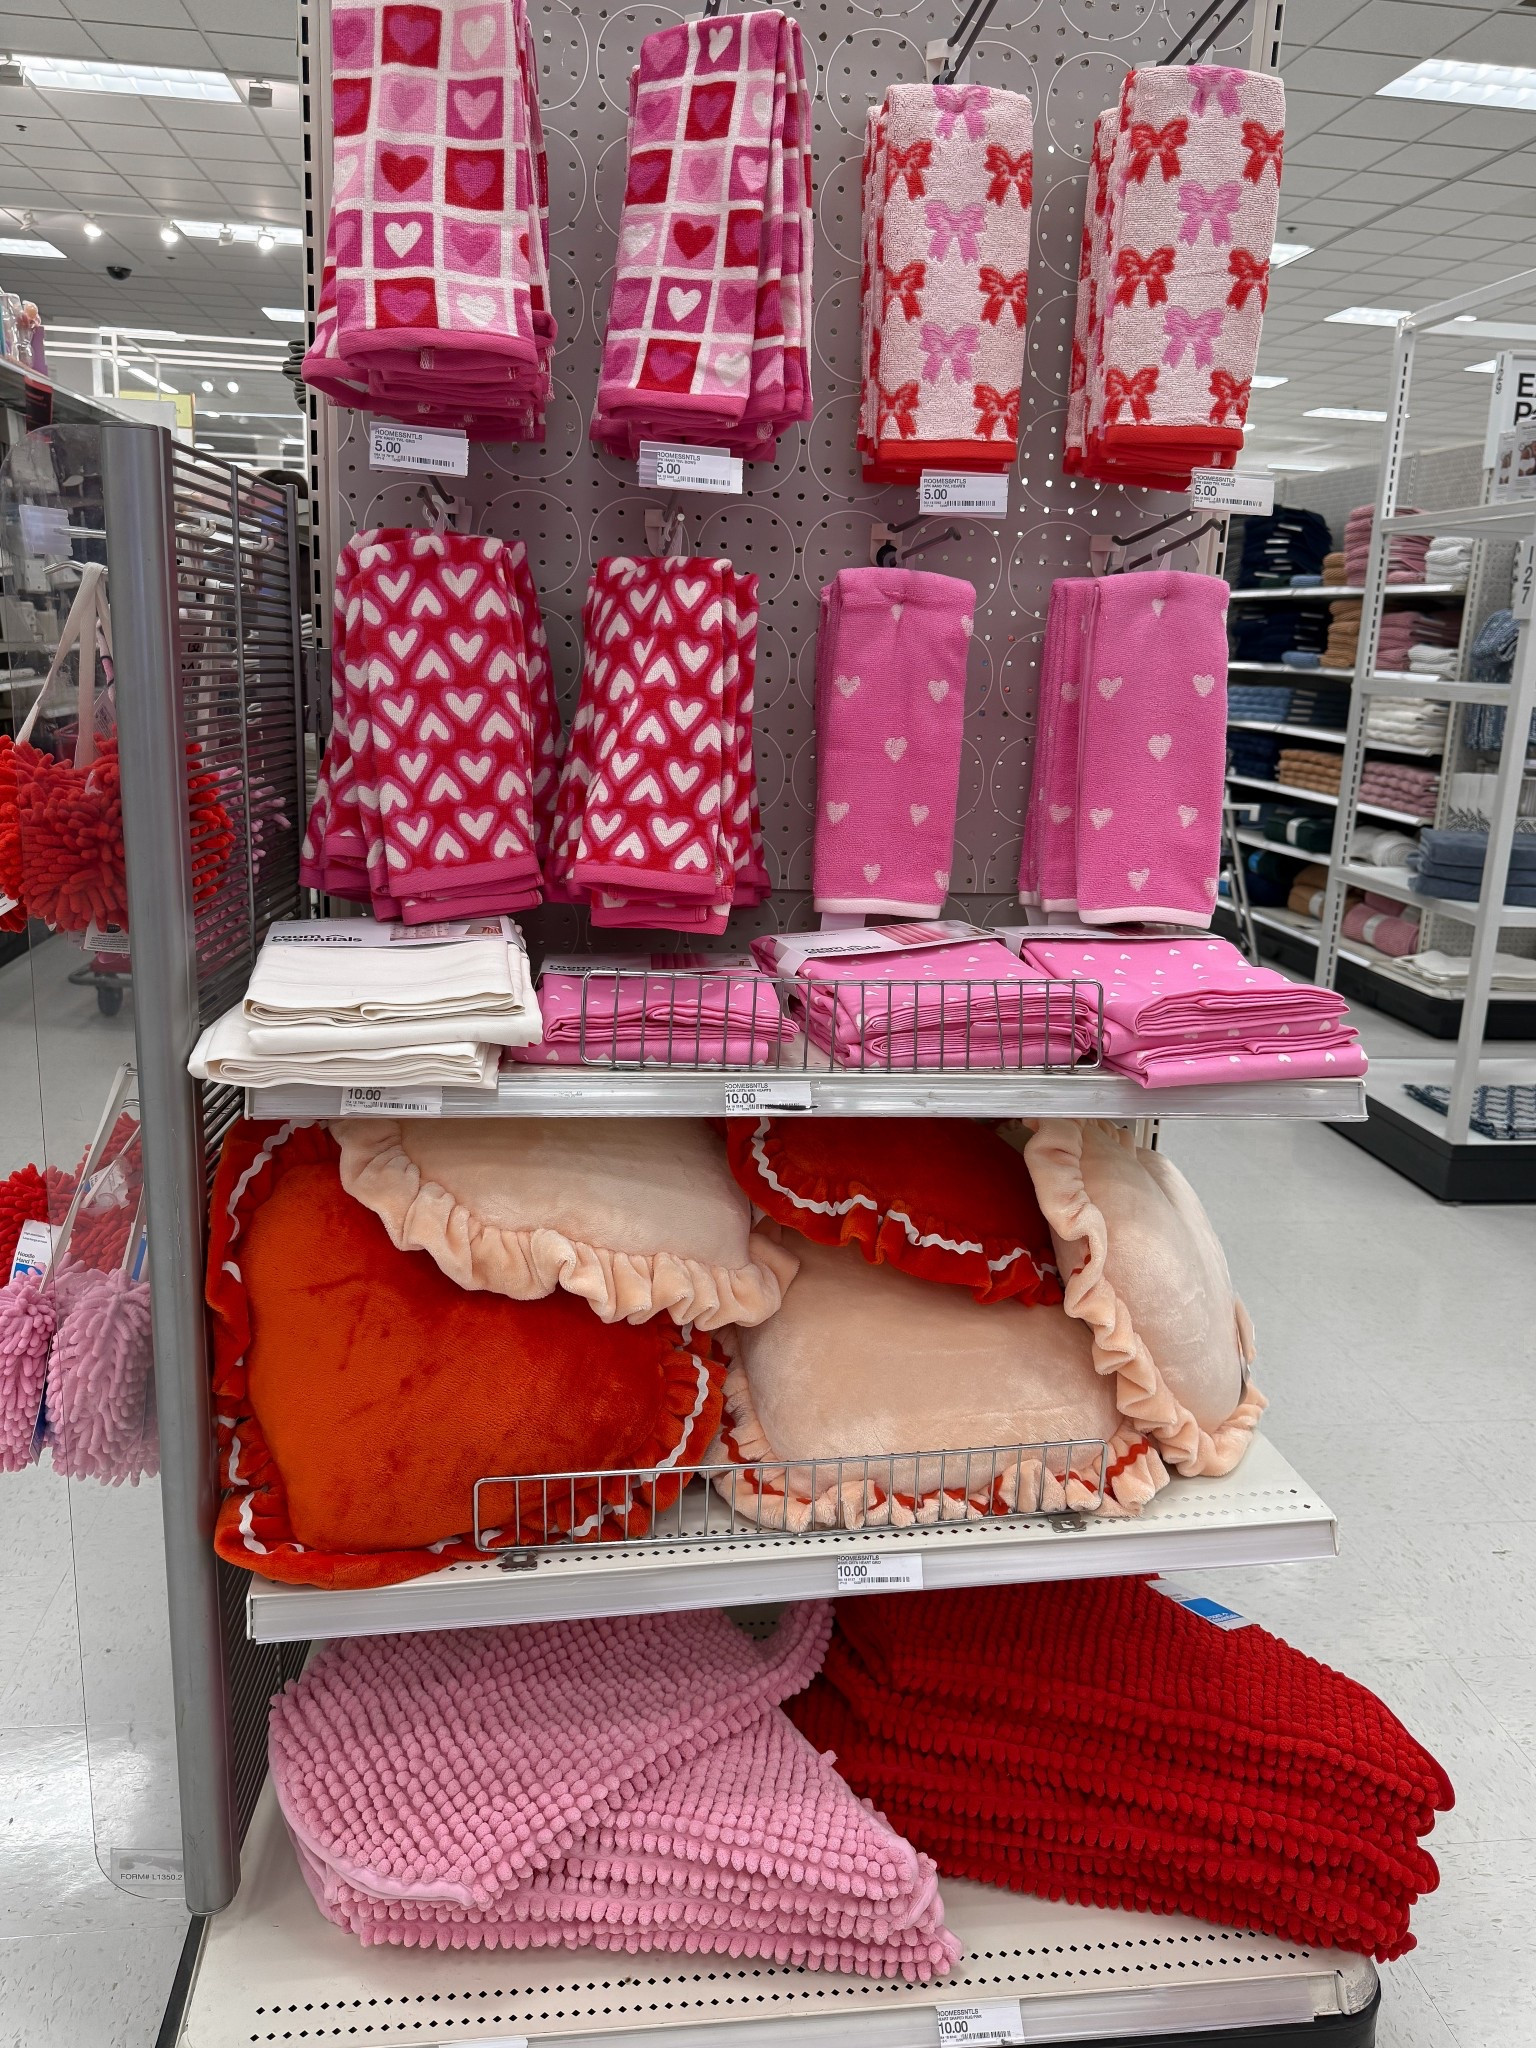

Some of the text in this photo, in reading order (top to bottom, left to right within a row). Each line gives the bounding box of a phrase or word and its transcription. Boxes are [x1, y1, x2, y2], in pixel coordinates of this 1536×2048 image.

[1517, 373, 1536, 398] E
[375, 440, 401, 454] 5.00
[657, 462, 681, 475] 5.00
[924, 488, 947, 500] 5.00
[1195, 485, 1217, 496] 5.00
[1522, 546, 1534, 604] 127
[348, 1088, 381, 1101] 10.00
[725, 1093, 755, 1104] 10.00
[838, 1566, 867, 1576] 10.00
[939, 2021, 968, 2034] 10.00
